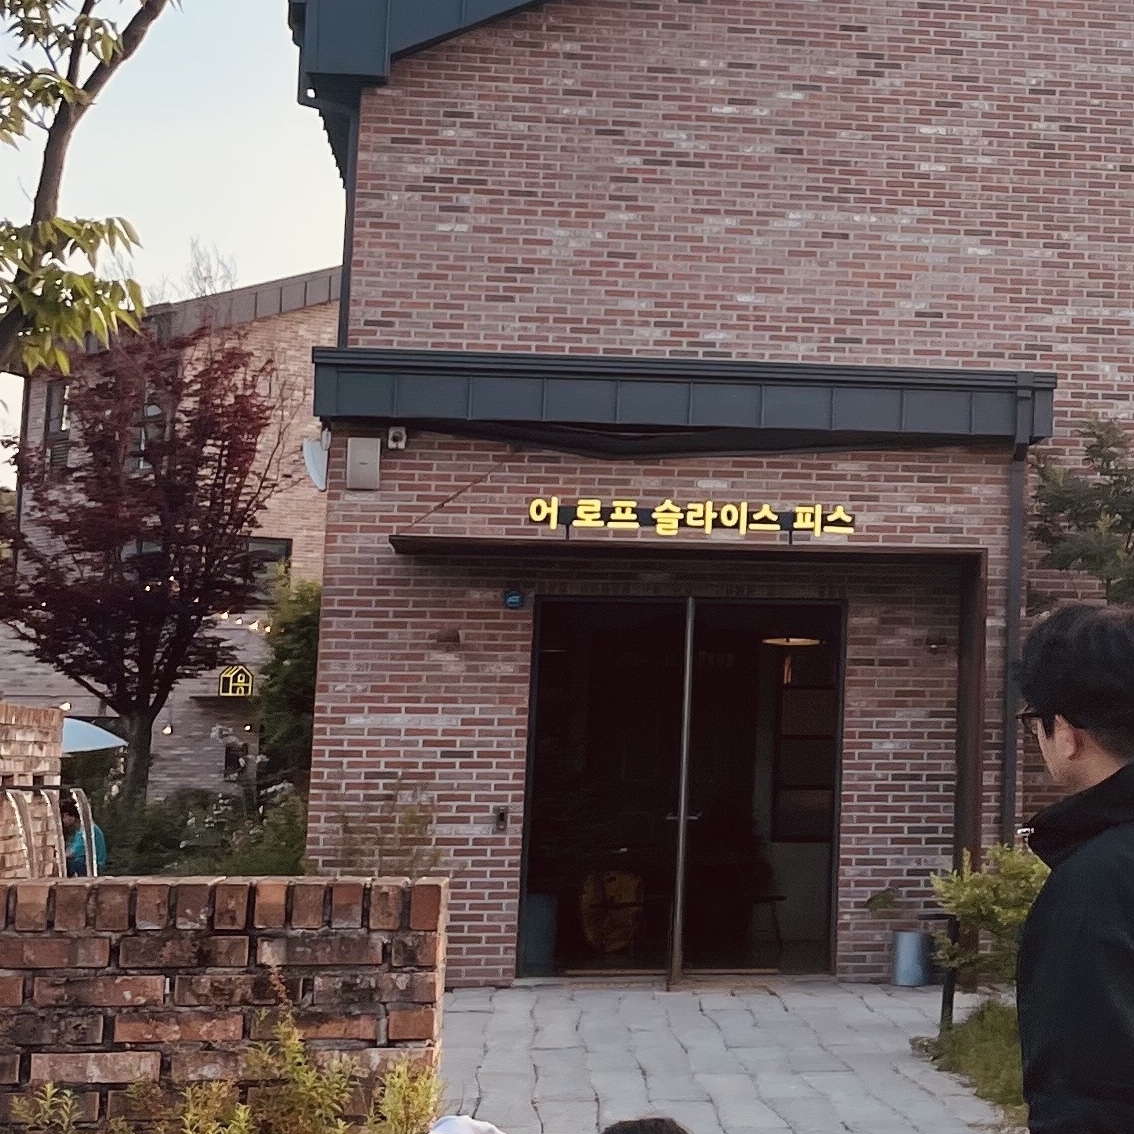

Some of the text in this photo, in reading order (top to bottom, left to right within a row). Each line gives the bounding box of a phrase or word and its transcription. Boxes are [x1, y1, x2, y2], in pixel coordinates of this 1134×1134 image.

[529, 497, 855, 538] 어 로프 슬라이스 피스
